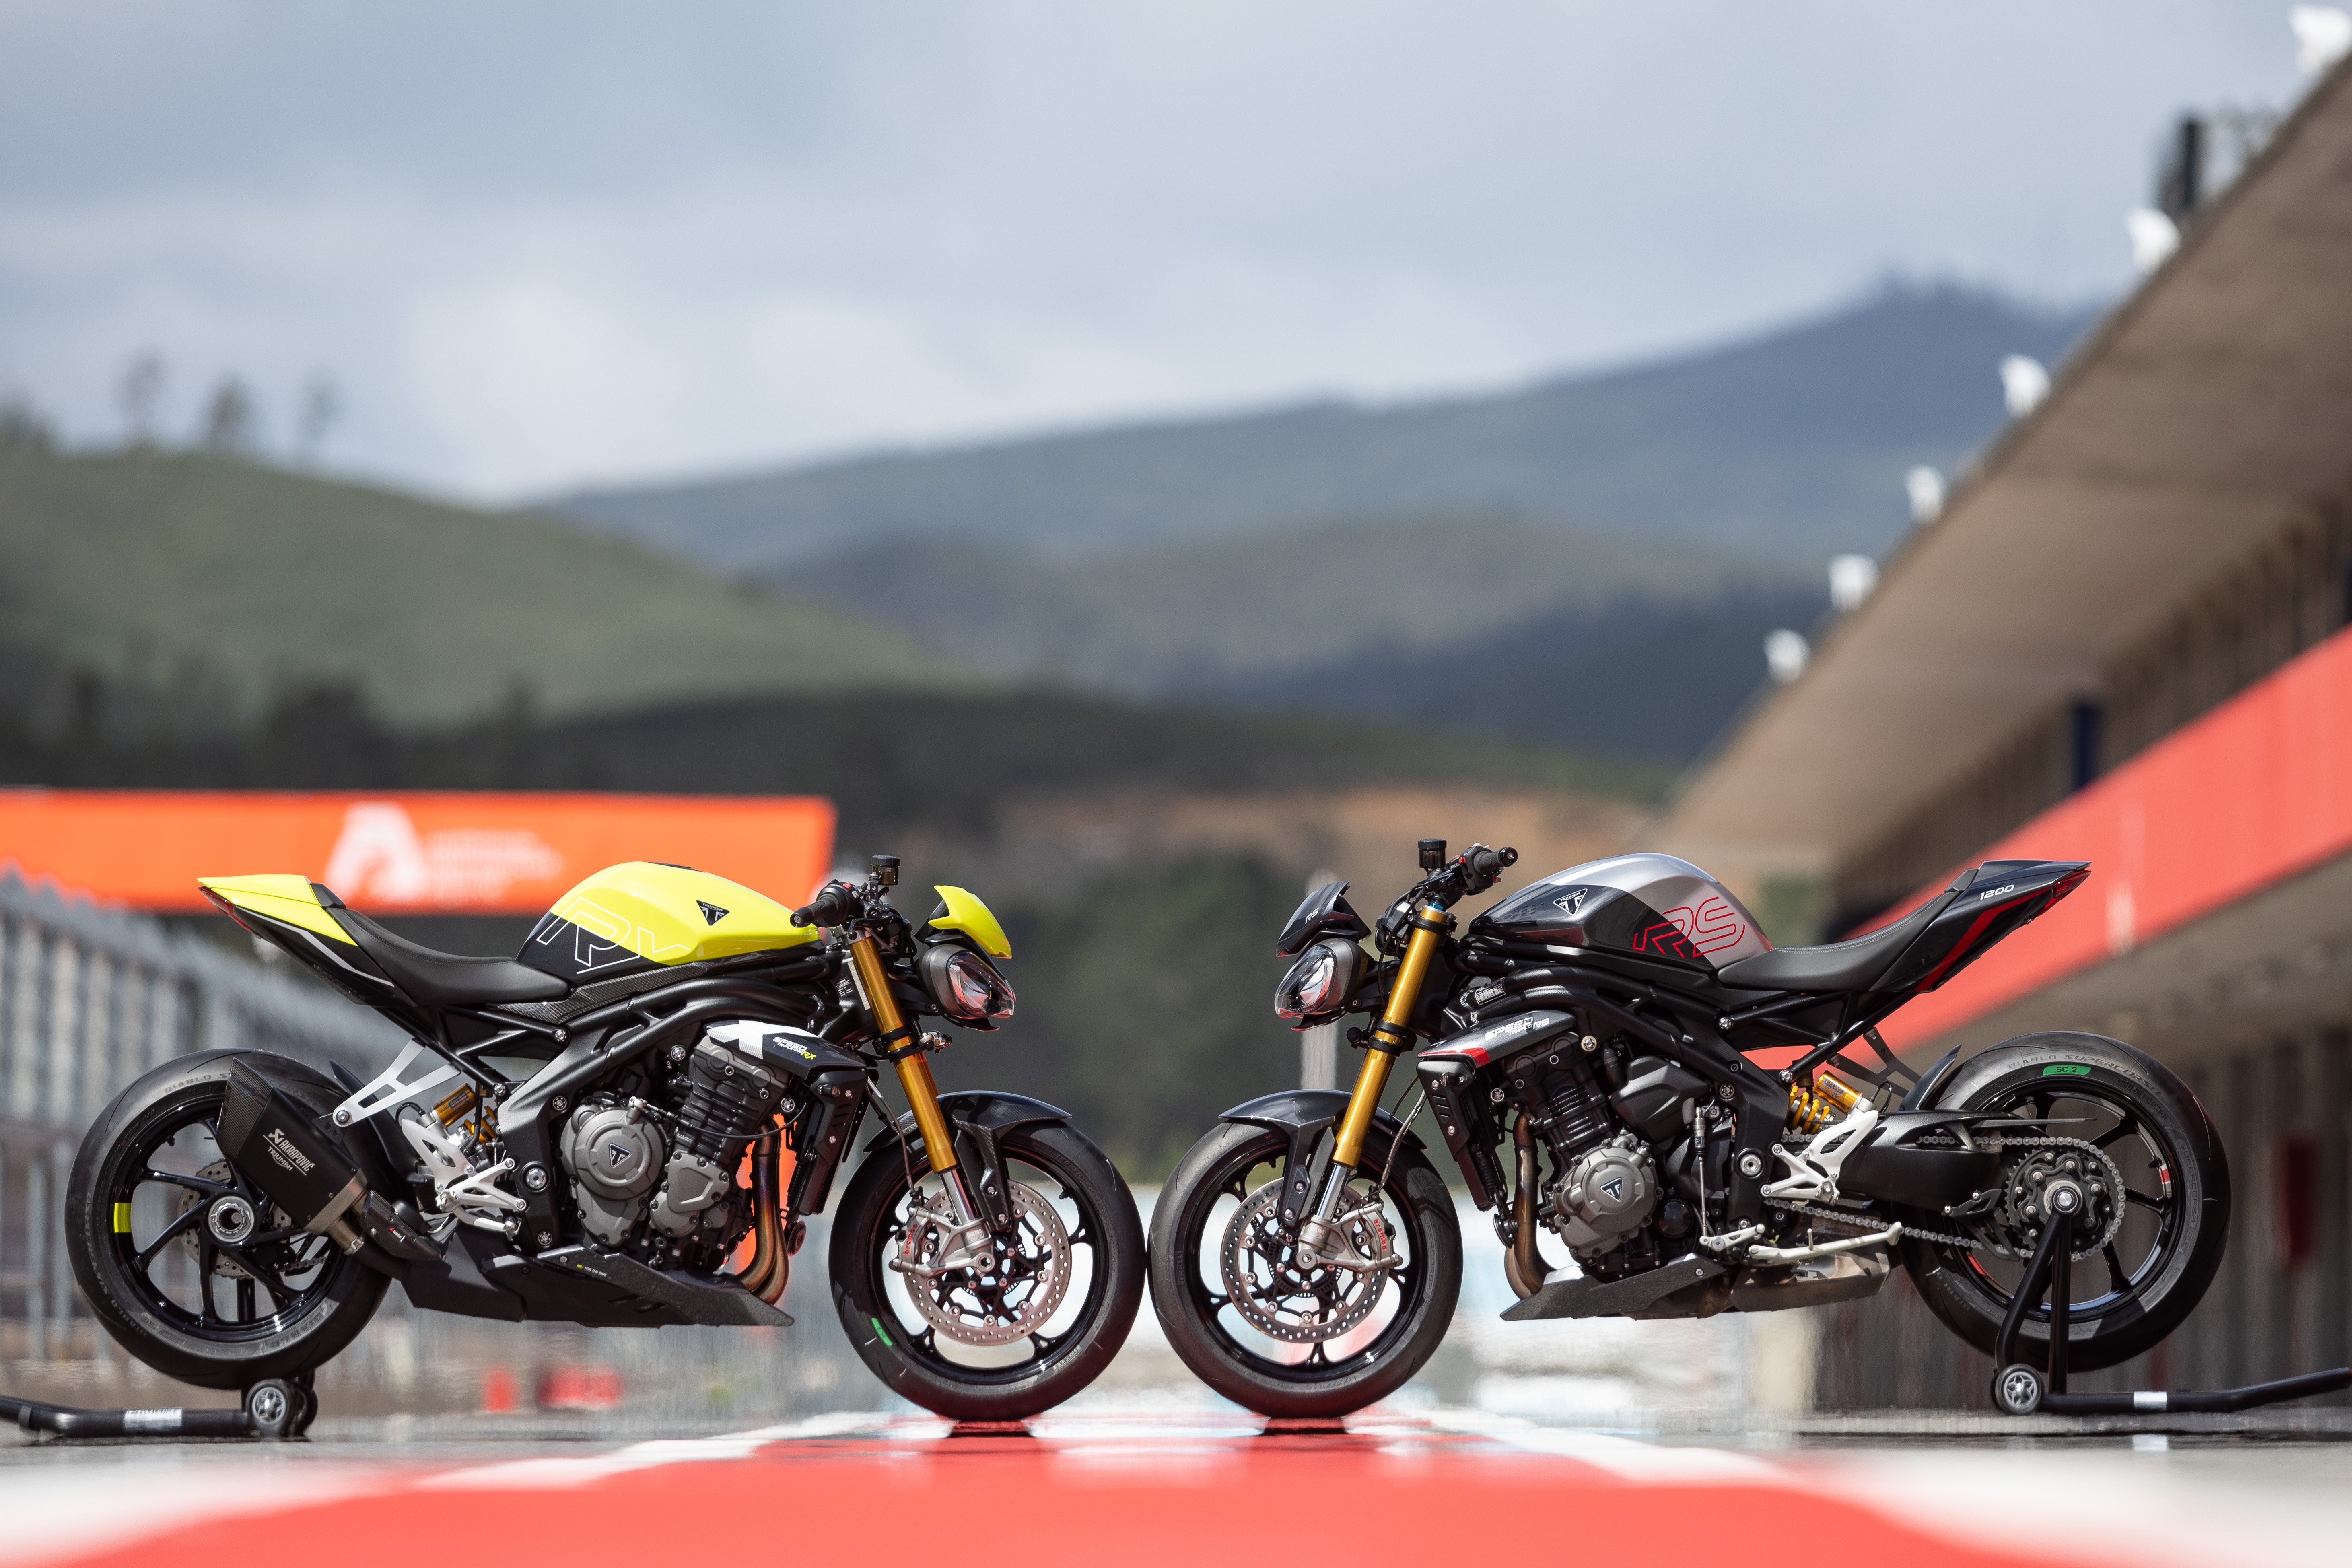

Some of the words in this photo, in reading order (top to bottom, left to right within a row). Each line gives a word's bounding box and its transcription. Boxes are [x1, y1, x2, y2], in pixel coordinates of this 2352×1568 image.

[1559, 892, 1580, 902] TRIUMPH
[1980, 884, 2014, 900] 1200
[702, 902, 723, 912] TRIUMPH
[1305, 907, 1319, 924] RS
[1633, 896, 1745, 958] RS
[1485, 1016, 1534, 1041] SPEED
[1508, 1024, 1532, 1036] TRIPLE
[1533, 1018, 1550, 1030] RS
[772, 1036, 807, 1051] SPEED
[800, 1051, 817, 1060] RX
[163, 1073, 212, 1094] DIABLO
[2007, 1053, 2056, 1070] DIABLO
[2063, 1054, 2163, 1096] SUPERCORSA
[2117, 1078, 2168, 1120] DIABLO
[268, 1146, 293, 1171] TRIUMPH
[278, 1140, 315, 1171] AKRAPOVIČ
[2179, 1142, 2198, 1224] SUPERCORSA
[903, 1223, 918, 1255] brembo
[966, 1228, 982, 1238] ÖHLINS
[1374, 1219, 1388, 1251] brembo
[1421, 1209, 1436, 1290] SUPERCORSA
[1174, 1250, 1185, 1287] PIRELLI
[109, 1298, 148, 1337] DIABLO
[1053, 1344, 1083, 1370] PIRELLI
